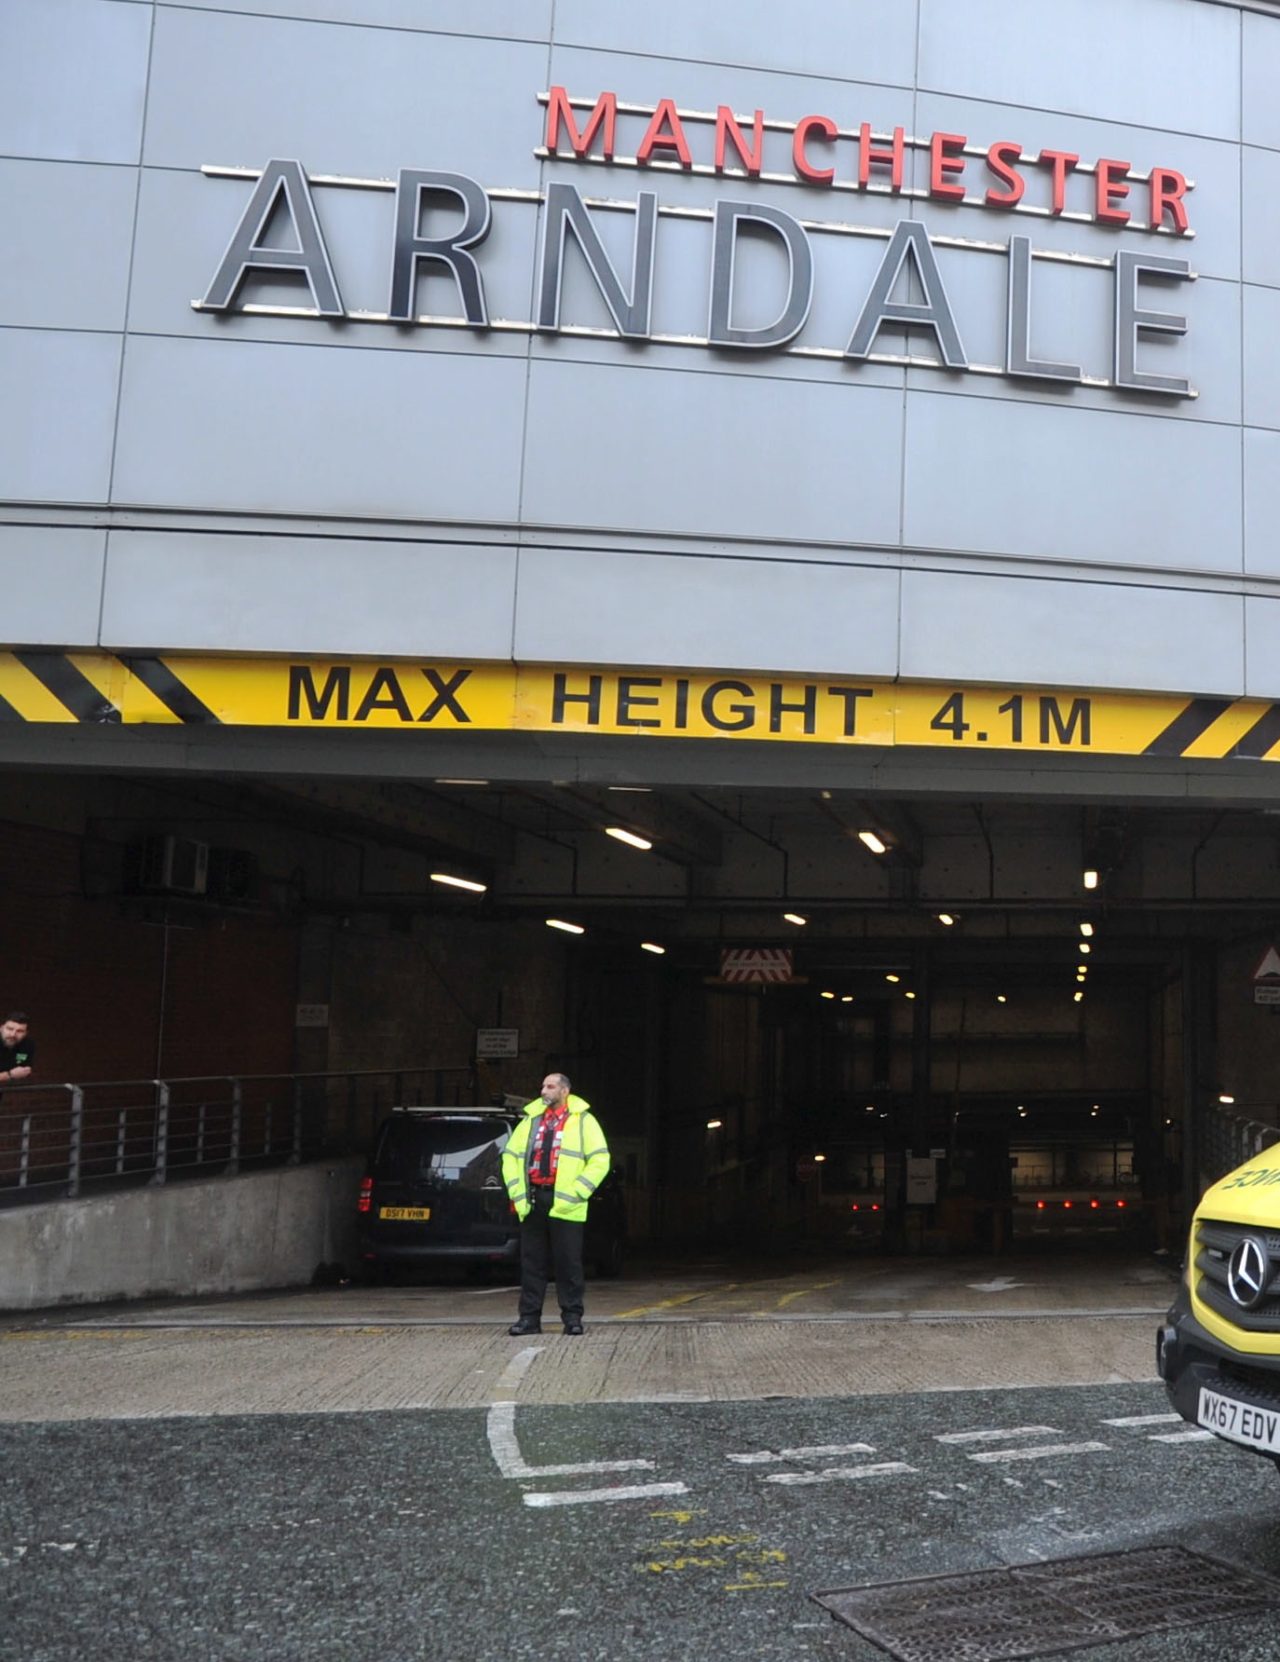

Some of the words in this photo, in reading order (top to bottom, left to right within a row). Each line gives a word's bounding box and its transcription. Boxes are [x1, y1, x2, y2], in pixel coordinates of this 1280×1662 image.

[546, 86, 1189, 234] MANCHESTER
[200, 159, 1191, 395] ARNDALE
[287, 665, 473, 723] MAX
[551, 673, 873, 737] HEIGHT
[930, 691, 1091, 746] 4.1M
[1241, 1408, 1277, 1444] EDV
